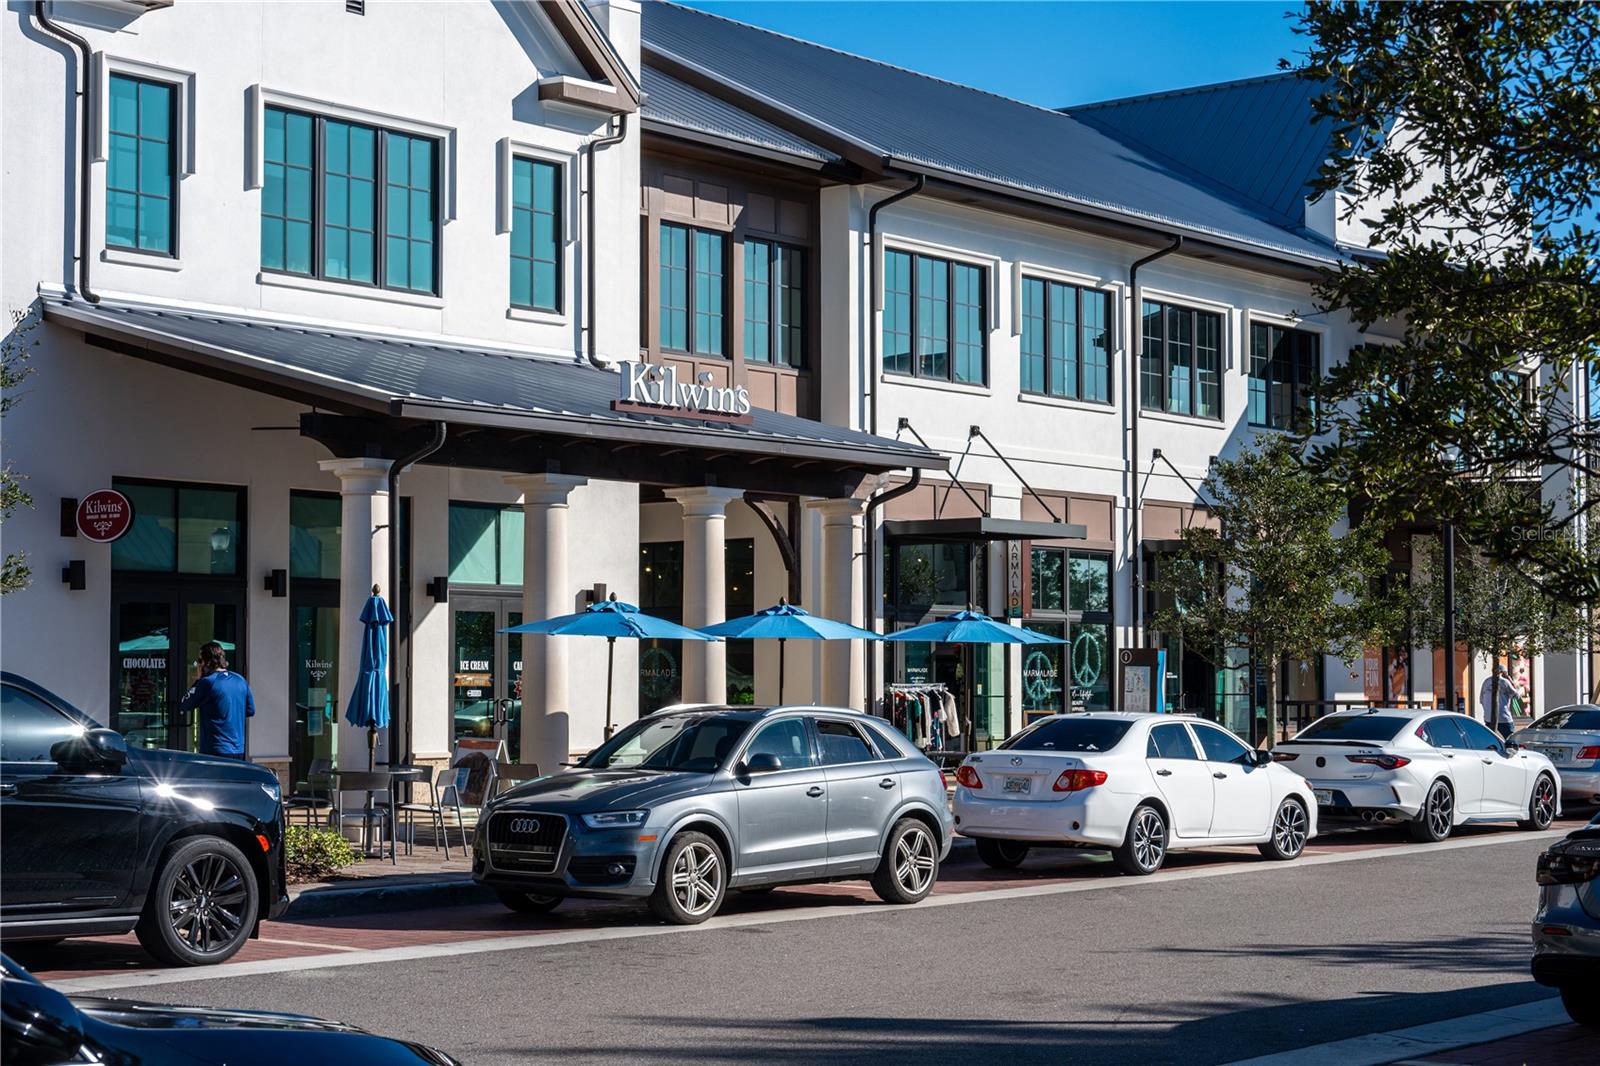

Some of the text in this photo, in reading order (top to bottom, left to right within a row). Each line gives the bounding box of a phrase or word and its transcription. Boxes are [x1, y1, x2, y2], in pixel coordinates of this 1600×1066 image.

[621, 360, 751, 414] Kilwins
[86, 500, 122, 514] Kilwins
[1011, 539, 1020, 615] ARMALADE
[123, 658, 166, 669] CHOCOLATES
[460, 660, 489, 671] ICE CREAM
[640, 668, 677, 678] RMALADE
[1023, 669, 1058, 678] MARMALADE
